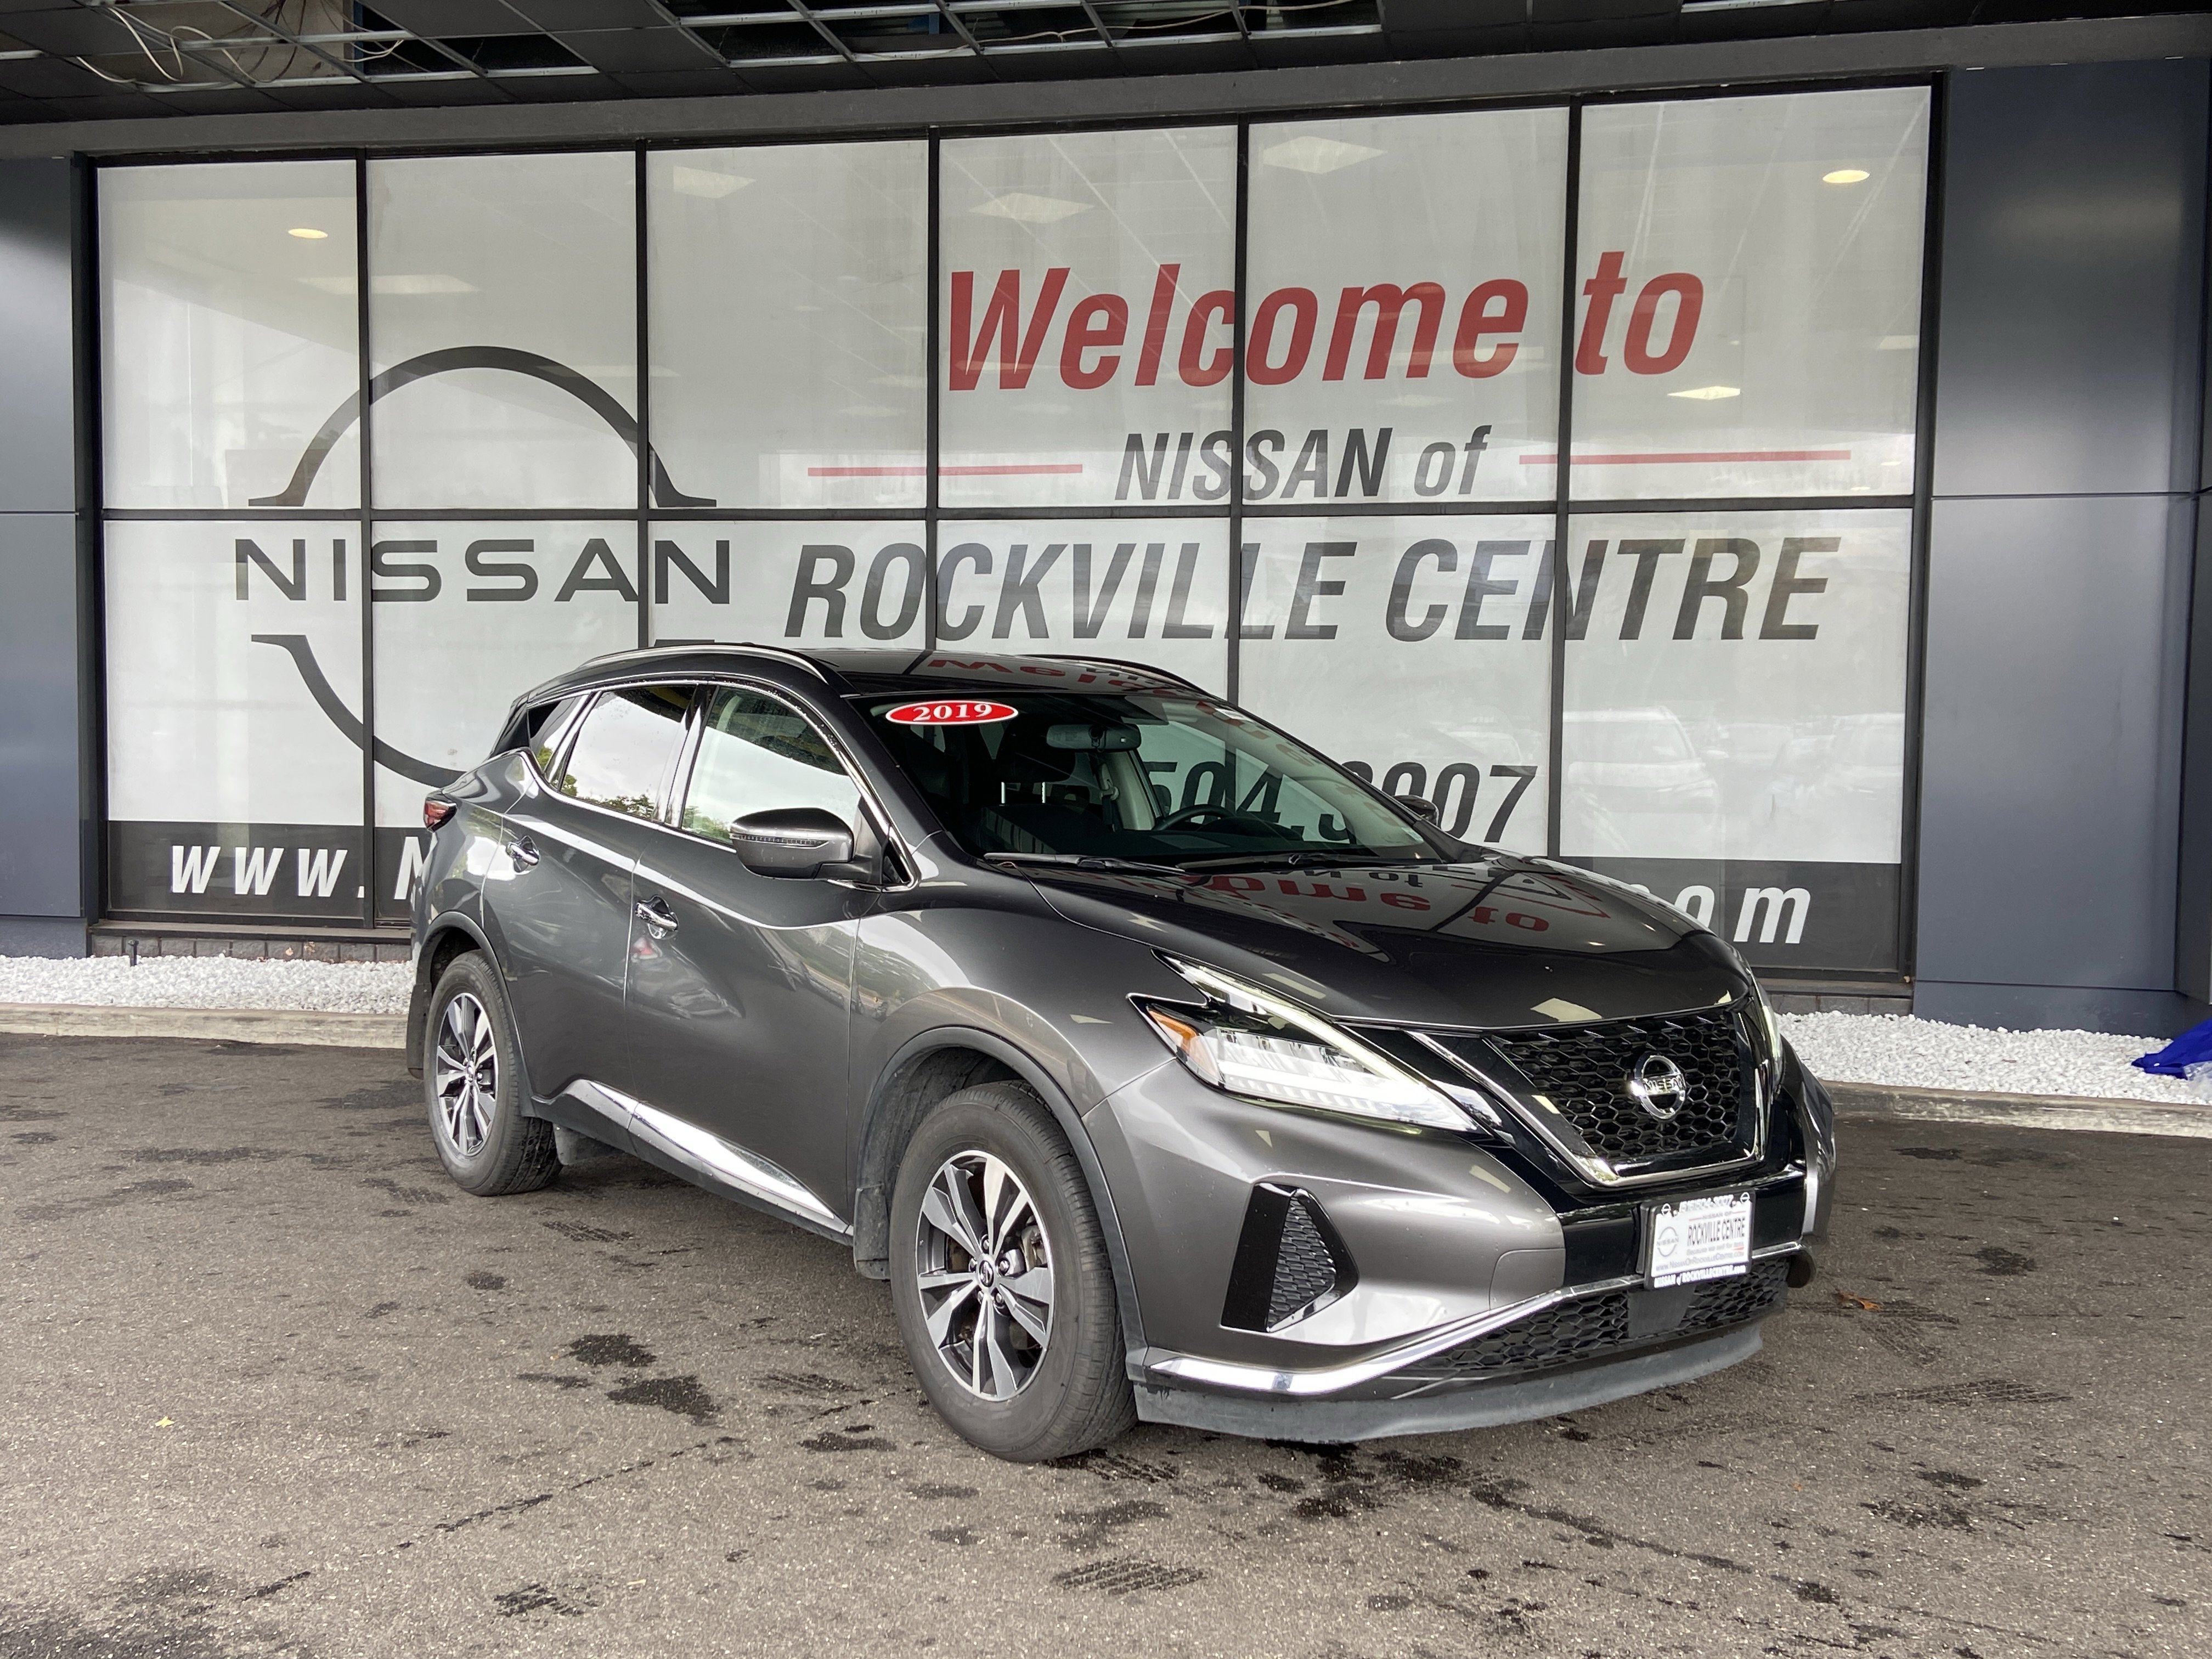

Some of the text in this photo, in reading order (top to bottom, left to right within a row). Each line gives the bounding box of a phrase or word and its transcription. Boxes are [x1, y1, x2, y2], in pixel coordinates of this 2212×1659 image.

[949, 251, 1703, 391] Welcome to
[1114, 425, 1492, 500] NISSAN of
[235, 538, 730, 605] NISSAN
[784, 537, 1842, 642] ROCKVILLE CENTRE
[912, 703, 992, 721] 2019
[1642, 1074, 1684, 1094] NISSAN
[1656, 1237, 1679, 1246] NISSAN
[1687, 1217, 1746, 1246] ROCKVILLE CENTRE
